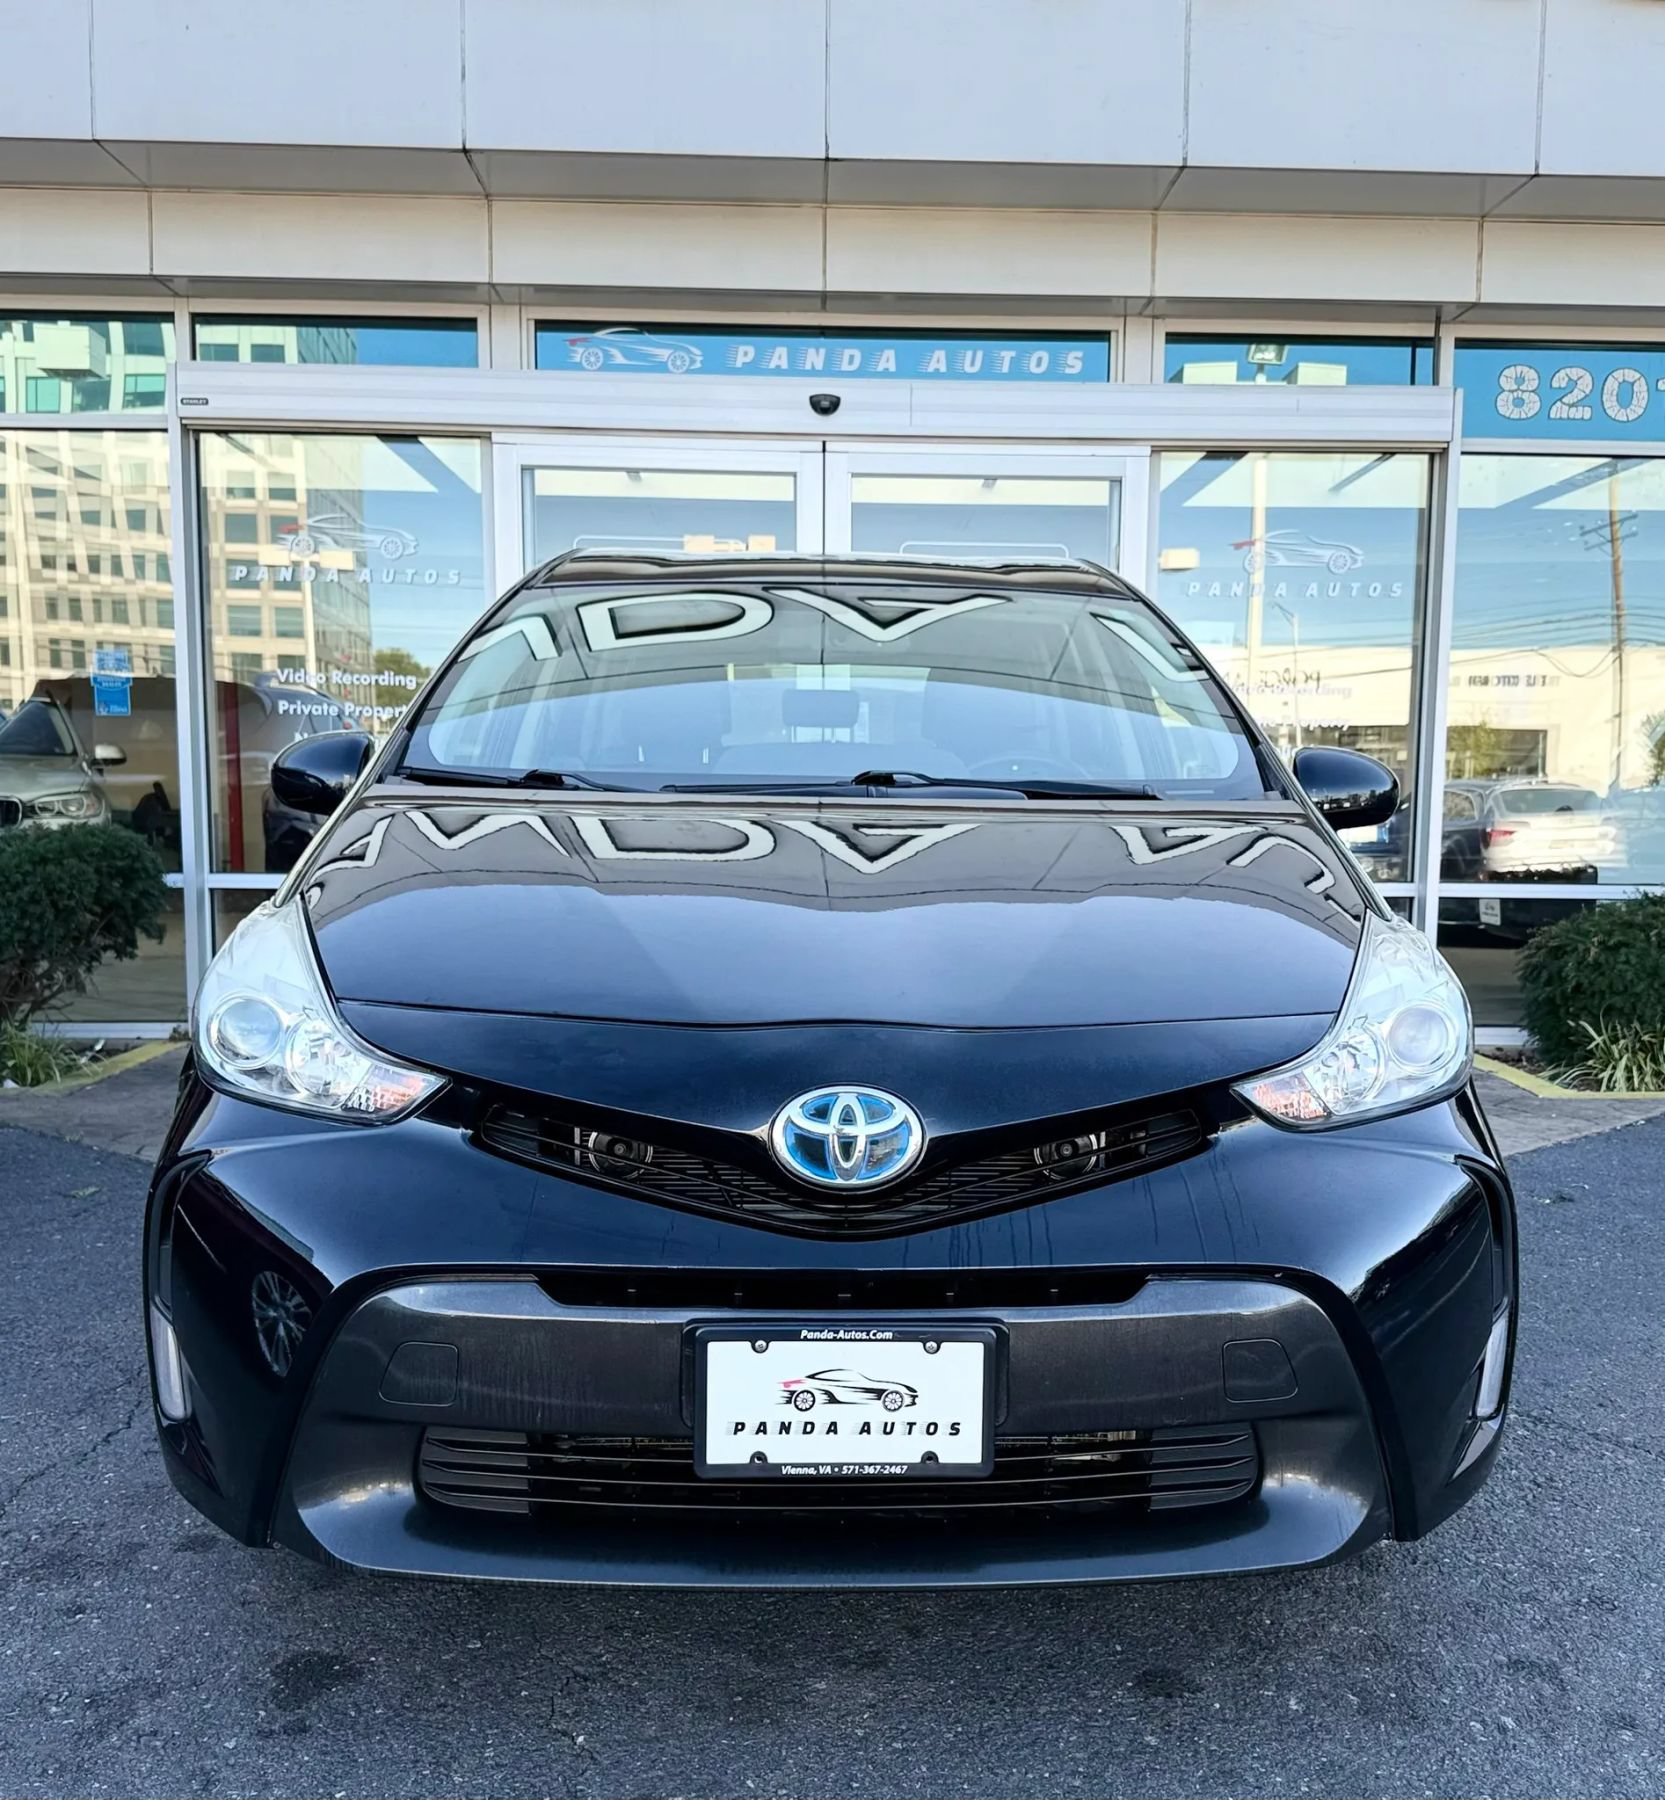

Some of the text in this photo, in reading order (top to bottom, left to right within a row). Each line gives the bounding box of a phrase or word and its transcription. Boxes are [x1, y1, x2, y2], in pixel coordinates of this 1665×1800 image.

[734, 345, 1084, 375] PANDA AUTOS
[1495, 363, 1665, 423] 820
[234, 566, 462, 584] PANDA AUTOS
[1187, 581, 1403, 597] PANDA AUTOS
[276, 668, 417, 690] Video Recording
[278, 700, 408, 721] Private Propert
[800, 1329, 893, 1341] Panda-Autos.Com
[733, 1421, 961, 1436] PANDA AUTOS
[781, 1465, 908, 1475] Vienna, VA 571-367-2467
